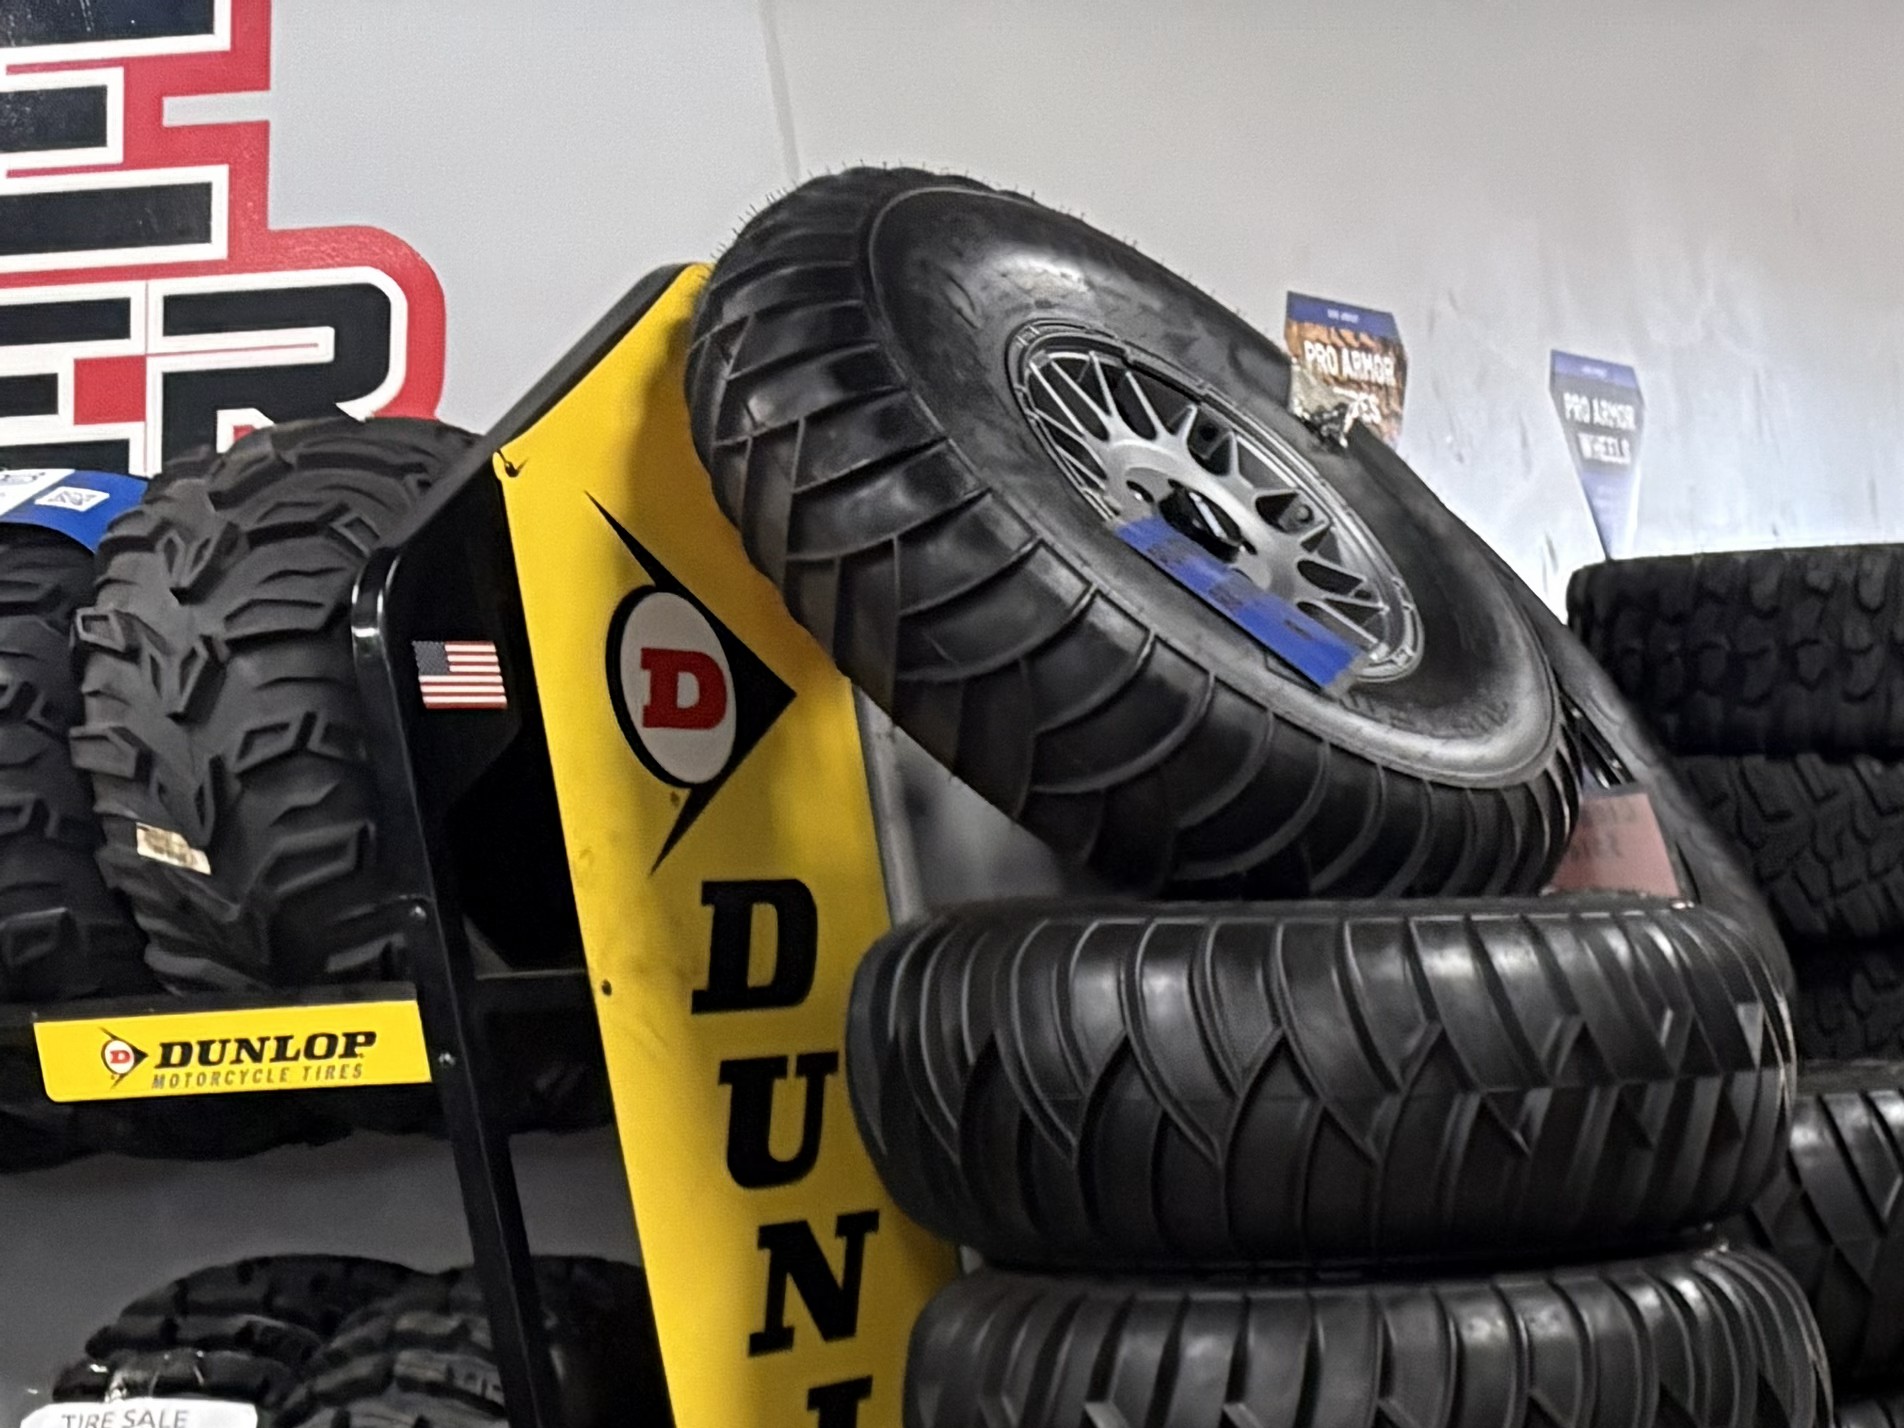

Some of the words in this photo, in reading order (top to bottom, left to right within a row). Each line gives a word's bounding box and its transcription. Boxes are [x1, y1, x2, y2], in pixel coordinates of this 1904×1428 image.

[1303, 339, 1341, 377] PRO
[1563, 391, 1591, 423] PRO
[155, 1030, 377, 1070] DUNLOP
[150, 1066, 293, 1090] MOTORCYCLE
[302, 1062, 366, 1083] TIRES
